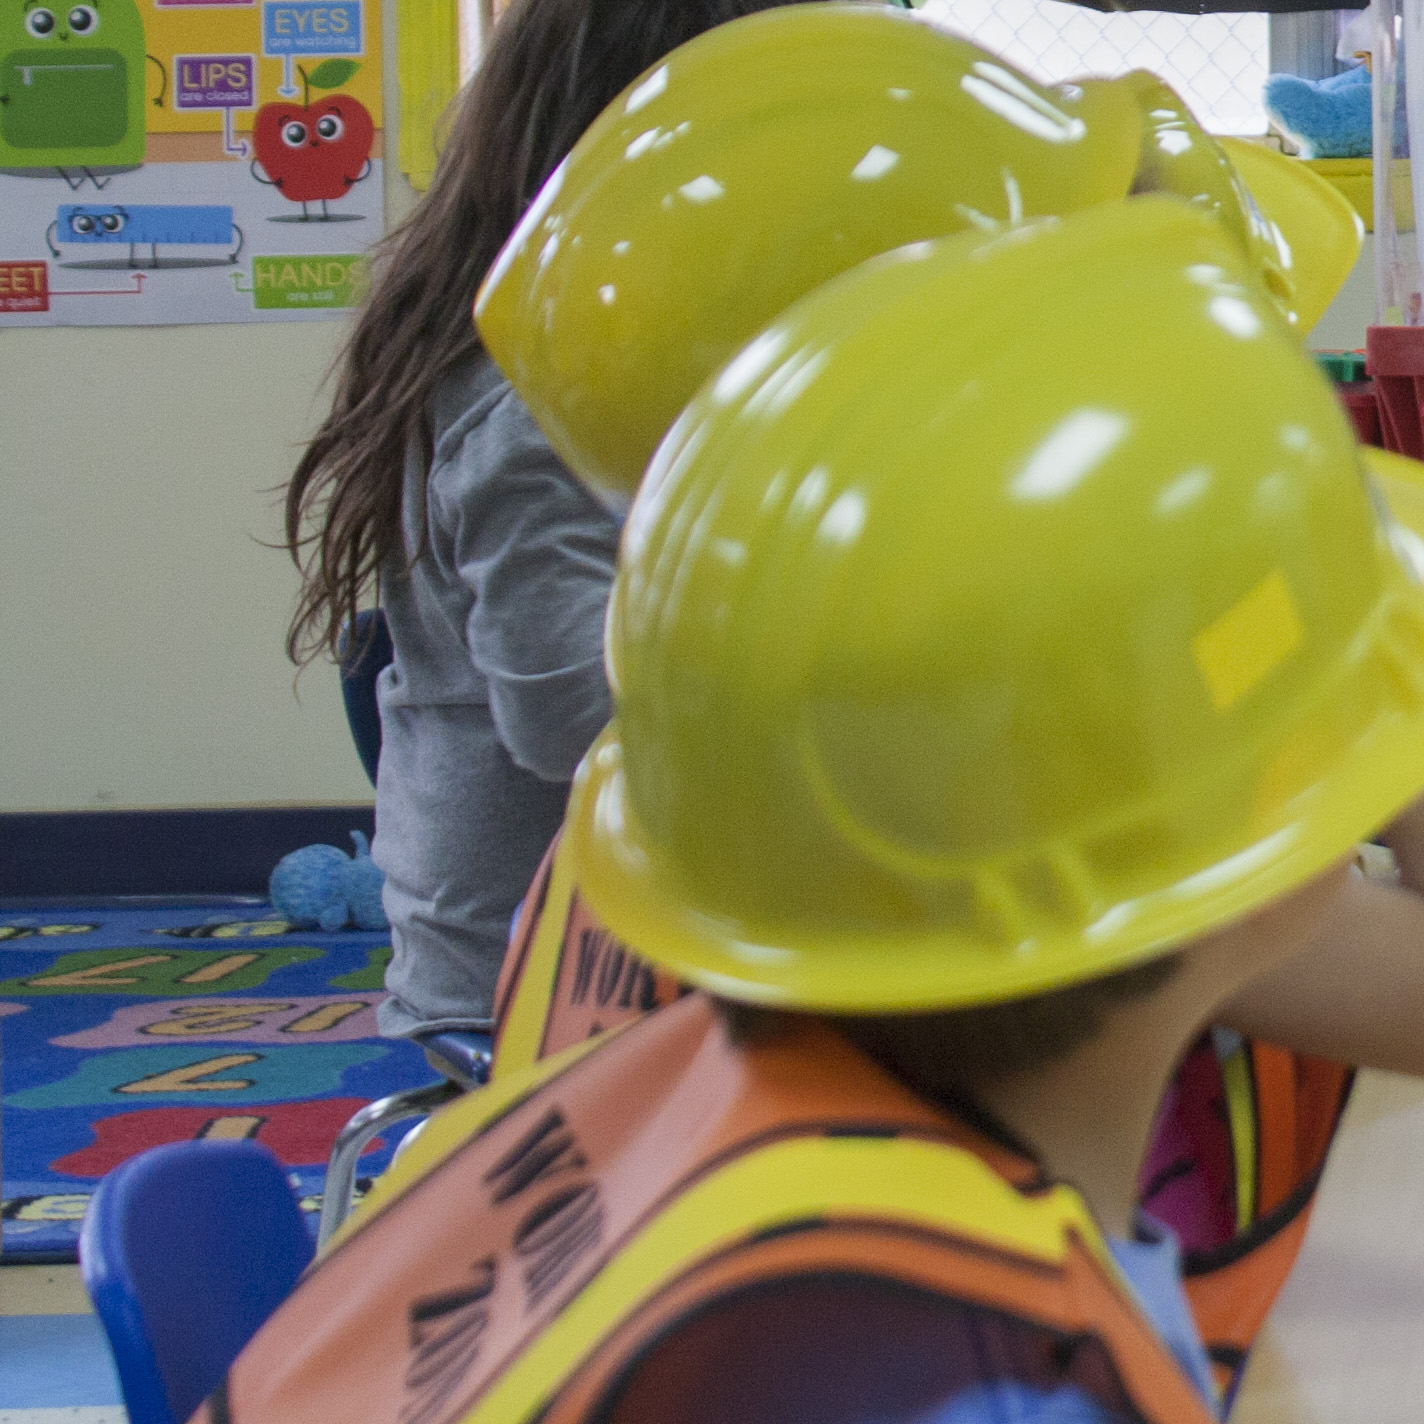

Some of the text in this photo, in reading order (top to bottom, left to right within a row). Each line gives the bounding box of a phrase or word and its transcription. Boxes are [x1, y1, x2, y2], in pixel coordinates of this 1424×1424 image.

[275, 8, 350, 34] EYES
[268, 36, 357, 50] are watching
[182, 62, 248, 90] LIPS
[181, 90, 249, 102] are closed
[0, 266, 44, 293] EET
[286, 292, 309, 302] are
